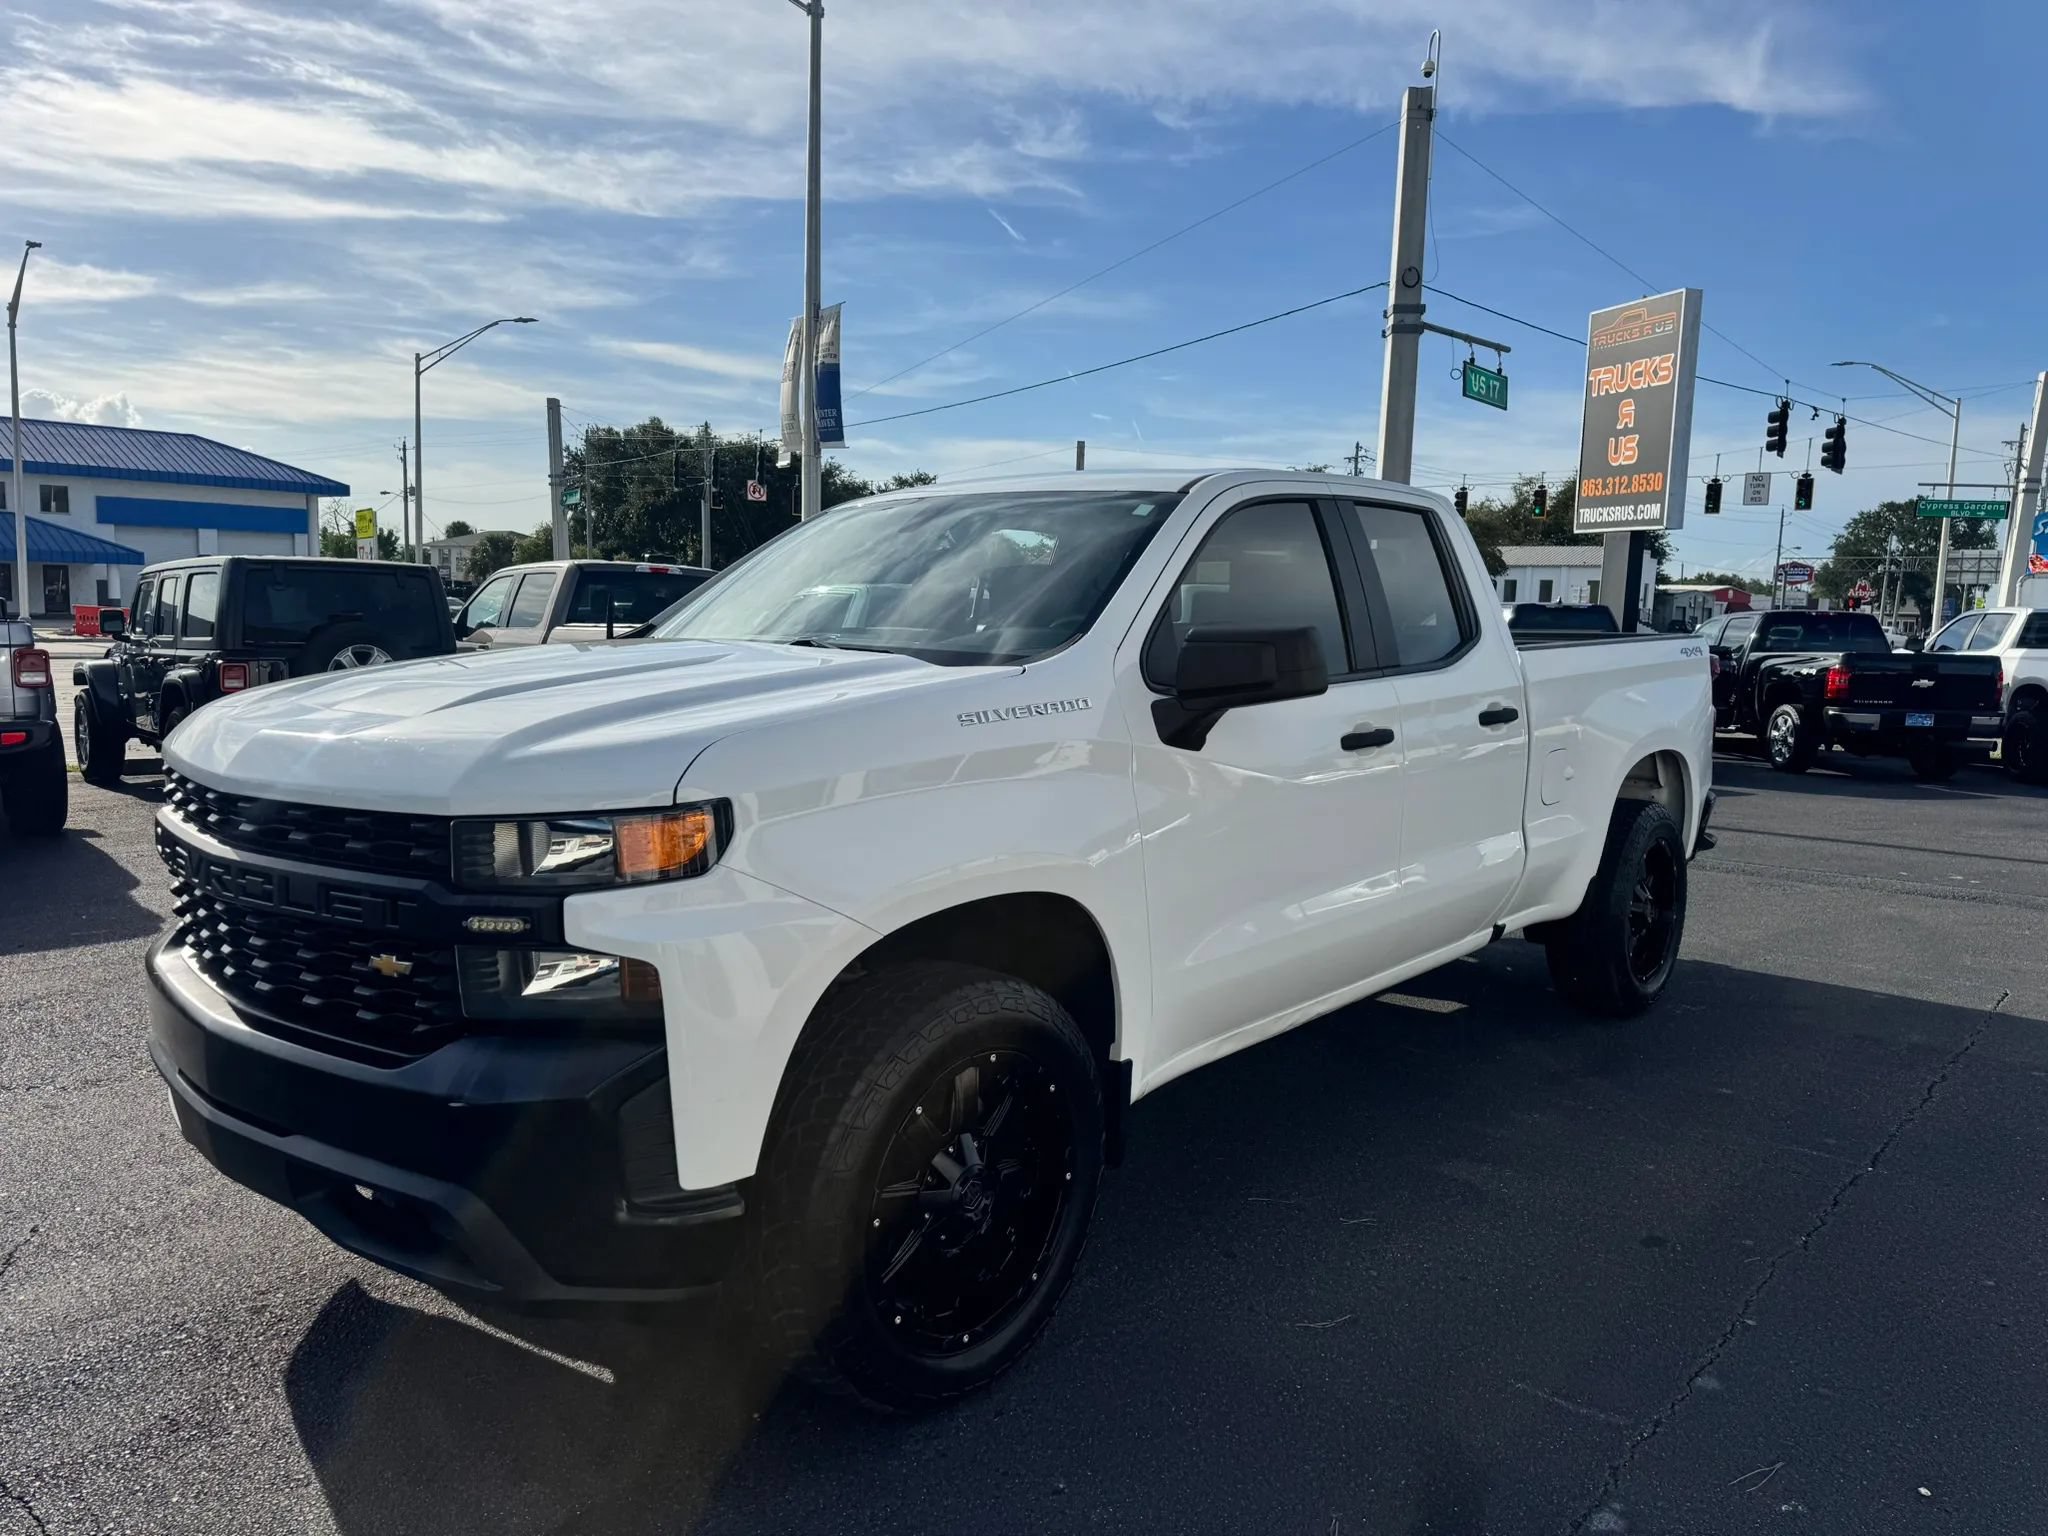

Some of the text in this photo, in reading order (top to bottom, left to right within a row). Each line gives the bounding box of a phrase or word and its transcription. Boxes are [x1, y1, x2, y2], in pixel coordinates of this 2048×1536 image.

[1593, 328, 1640, 347] TRUCKS
[1655, 320, 1673, 332] US
[1472, 372, 1500, 400] US 17
[1589, 353, 1675, 397] TRUCKS
[1608, 434, 1639, 466] US
[1581, 472, 1665, 497] 863.312.8530
[1579, 503, 1661, 523] TRUCKSRUS.COM
[1920, 502, 2005, 511] Cypress Gardens
[1848, 588, 1876, 598] Arby's
[957, 697, 1093, 727] SILVERADO
